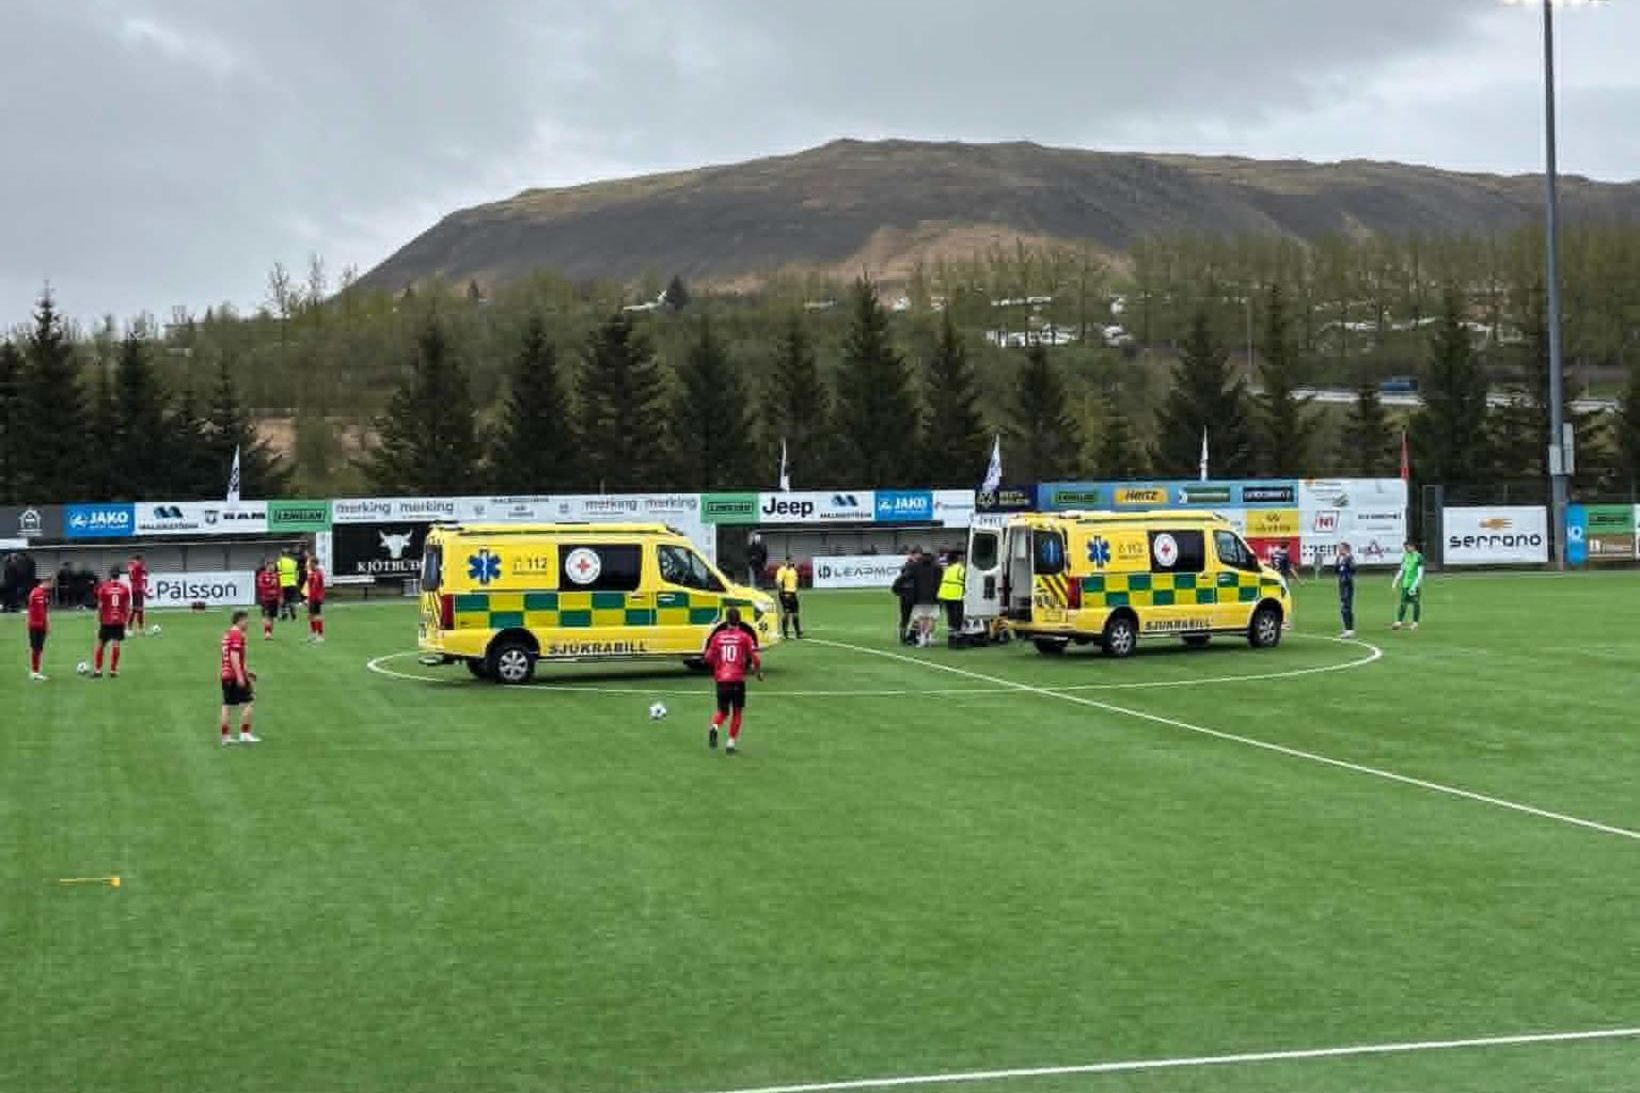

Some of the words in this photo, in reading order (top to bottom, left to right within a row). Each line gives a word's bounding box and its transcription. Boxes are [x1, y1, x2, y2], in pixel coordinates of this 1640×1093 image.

[337, 500, 391, 514] merking
[401, 500, 454, 514] merking
[762, 497, 814, 518] Jeep
[89, 511, 128, 523] JAKO
[1449, 534, 1542, 548] serrano
[527, 556, 548, 569] 112
[834, 566, 901, 577] LEAPMO
[156, 581, 237, 599] Pálsson
[721, 645, 737, 662] 10
